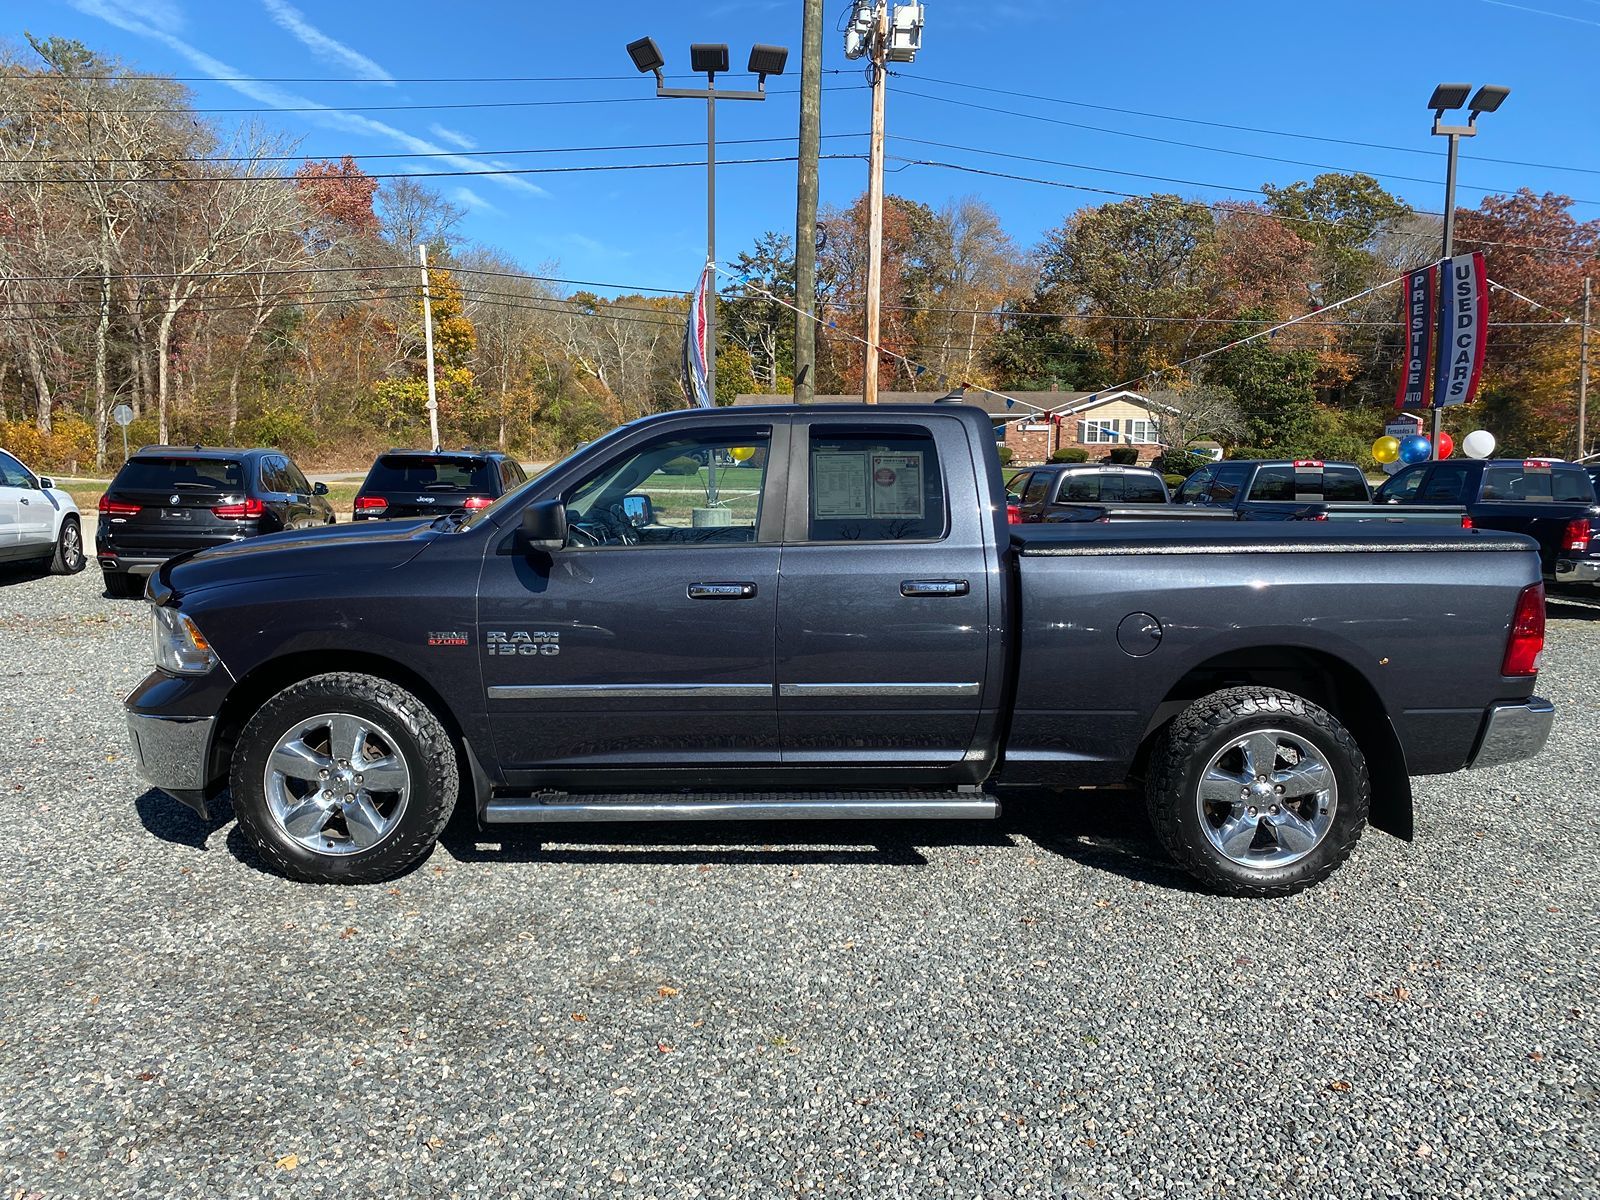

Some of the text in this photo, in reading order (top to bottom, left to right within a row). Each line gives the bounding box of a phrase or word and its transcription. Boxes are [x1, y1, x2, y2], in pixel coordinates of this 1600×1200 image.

[1409, 275, 1424, 385] PRESTIGE
[1450, 264, 1473, 396] USED CARS
[1404, 391, 1422, 402] AUTO
[416, 496, 435, 504] Jeep
[486, 631, 560, 643] RAM
[486, 643, 560, 656] 1500
